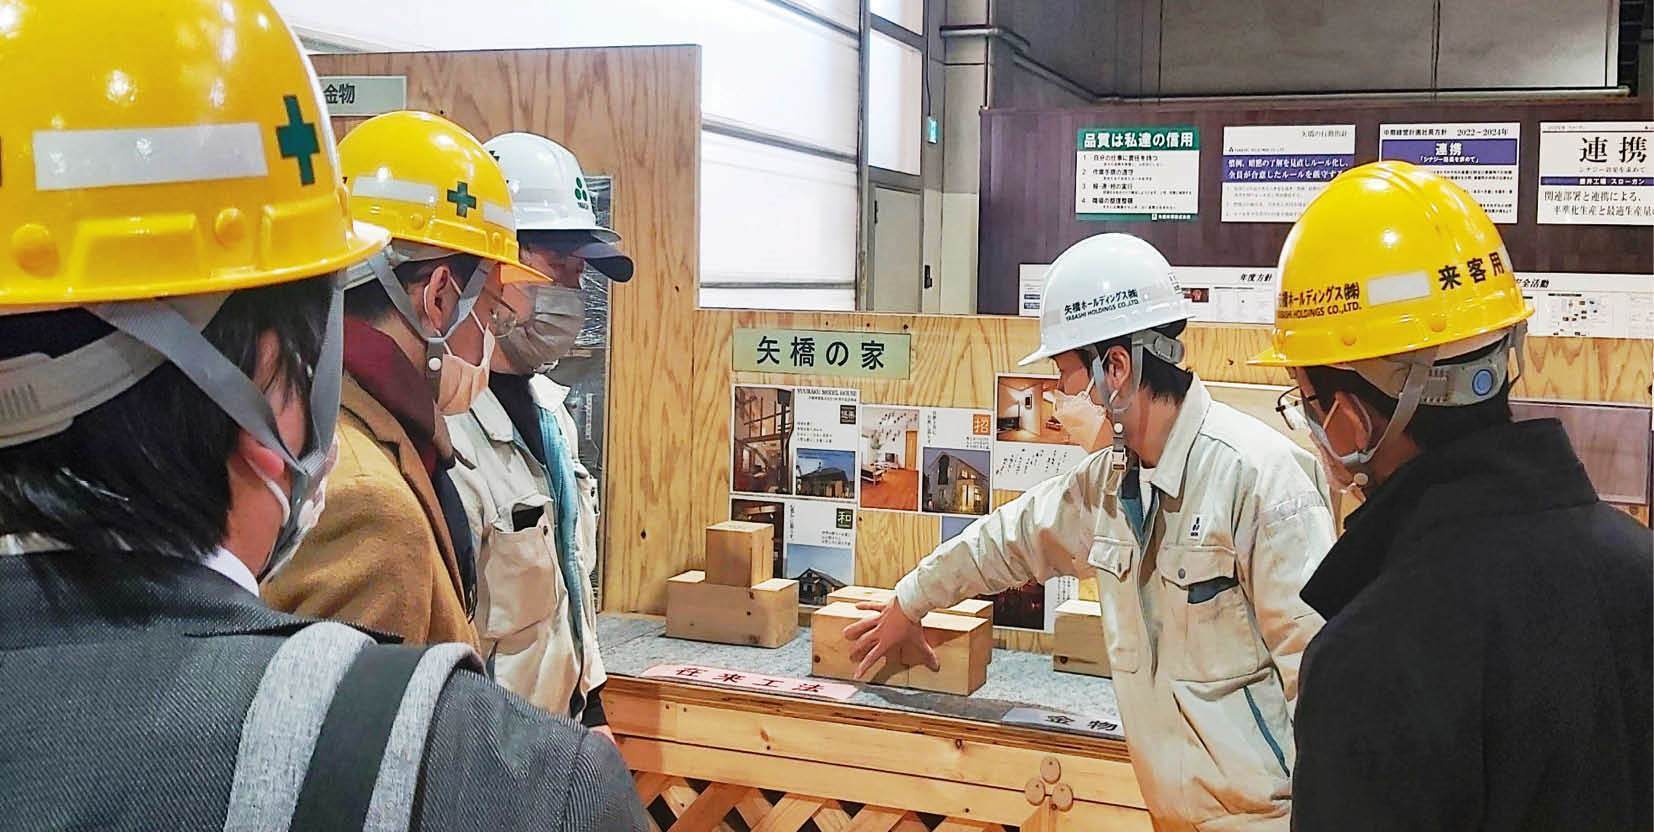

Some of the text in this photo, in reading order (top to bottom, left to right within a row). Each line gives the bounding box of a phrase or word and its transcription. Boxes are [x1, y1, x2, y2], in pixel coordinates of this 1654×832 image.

[323, 84, 355, 104] 金物
[1084, 132, 1194, 148] 品質は私達の信用
[1435, 142, 1462, 156] 連携
[1579, 136, 1647, 163] 連携
[1438, 252, 1504, 290] 来客用
[756, 335, 885, 370] 矢橋の家
[675, 667, 824, 693] 在来工法
[1045, 715, 1118, 731] 金物
